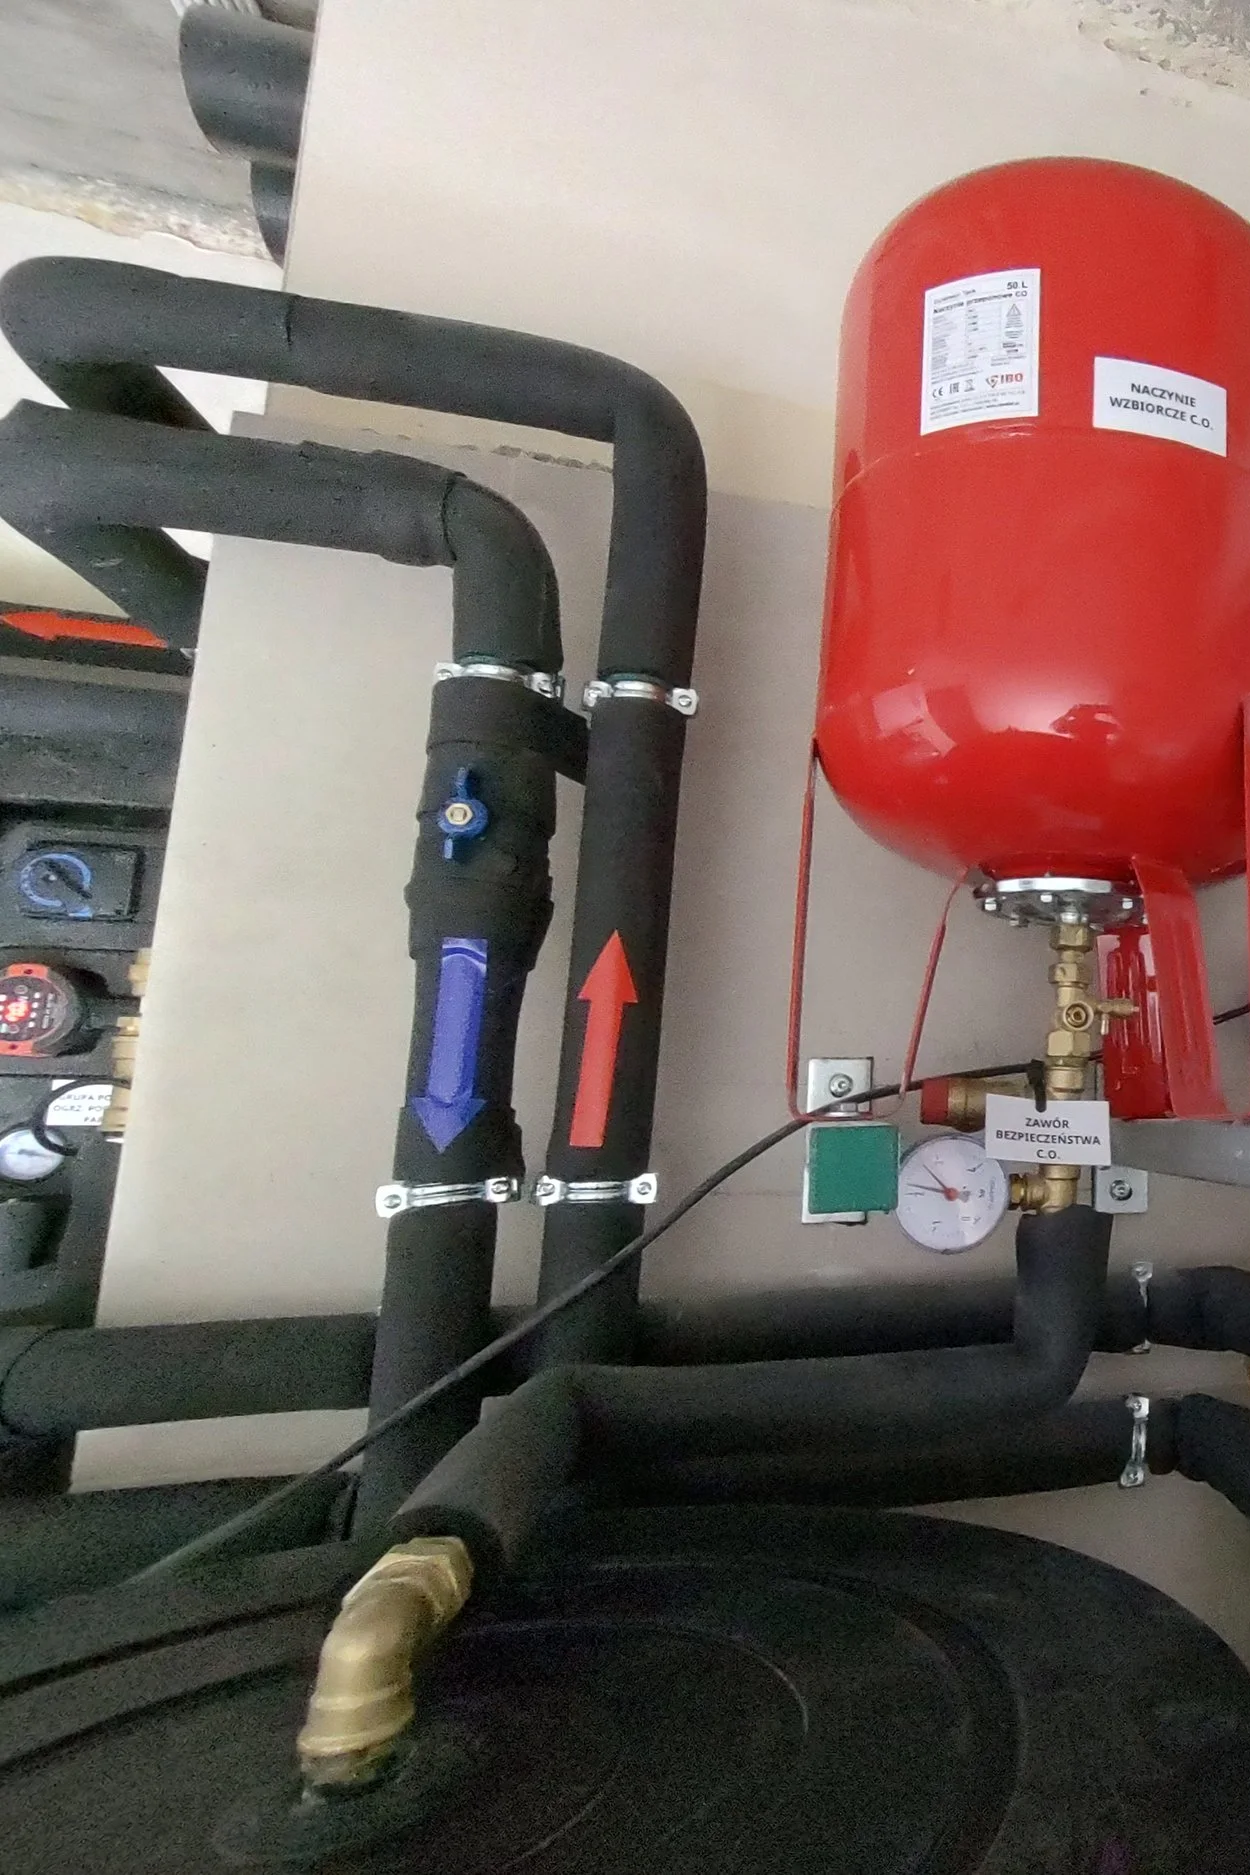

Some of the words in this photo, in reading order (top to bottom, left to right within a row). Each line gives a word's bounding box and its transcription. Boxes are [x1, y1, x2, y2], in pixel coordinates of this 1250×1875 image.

[1007, 282, 1018, 290] 50
[1021, 281, 1028, 289] L
[1130, 383, 1196, 408] NACZYNIE
[1109, 396, 1187, 422] WZBIORCZE
[1189, 414, 1214, 431] C.O.
[1025, 1117, 1069, 1129] ZAWÓR
[995, 1129, 1101, 1146] BEZPIECZEŃSTWA
[1036, 1149, 1062, 1160] C.O.
